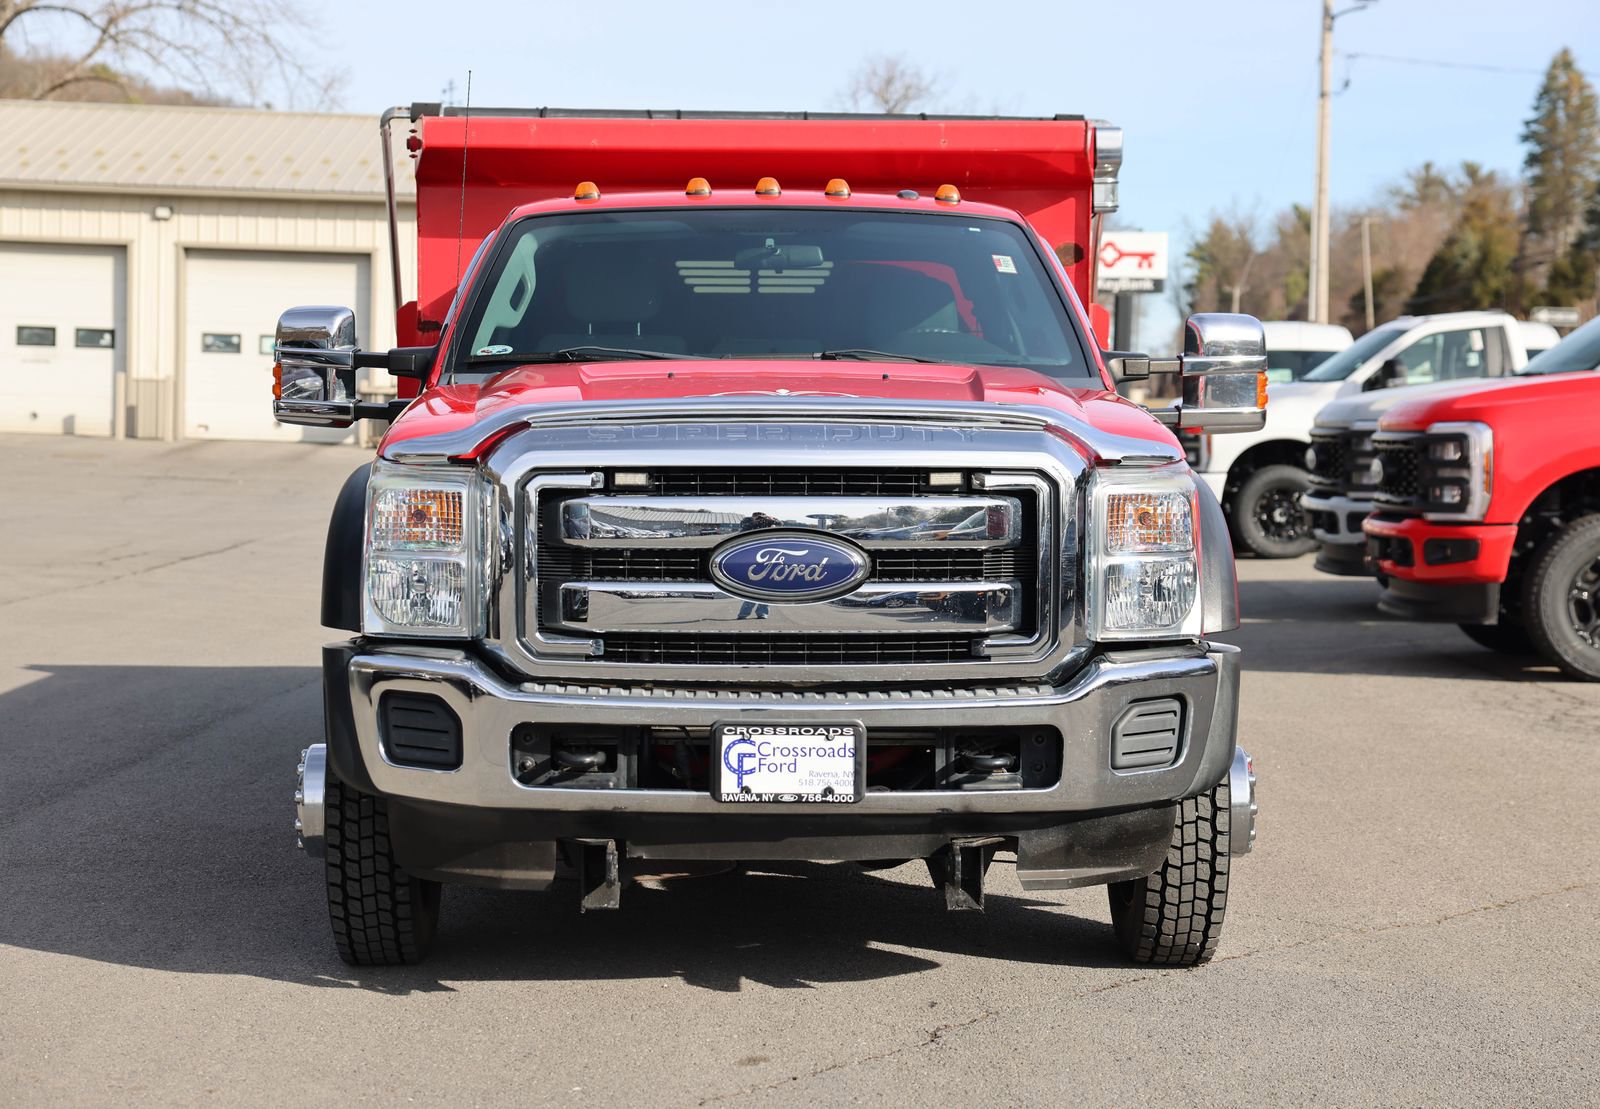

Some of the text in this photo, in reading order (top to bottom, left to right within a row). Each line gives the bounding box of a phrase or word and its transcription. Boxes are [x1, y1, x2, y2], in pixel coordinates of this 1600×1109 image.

[587, 424, 985, 442] SUPER DUTY
[747, 548, 829, 582] Ford
[723, 726, 854, 736] CROSSROADS
[757, 741, 855, 758] Crossroads
[758, 757, 797, 773] Ford
[808, 770, 841, 779] Ravena,
[721, 793, 760, 802] RAVENA,
[761, 793, 775, 802] NY
[801, 794, 854, 803] 756-4000
